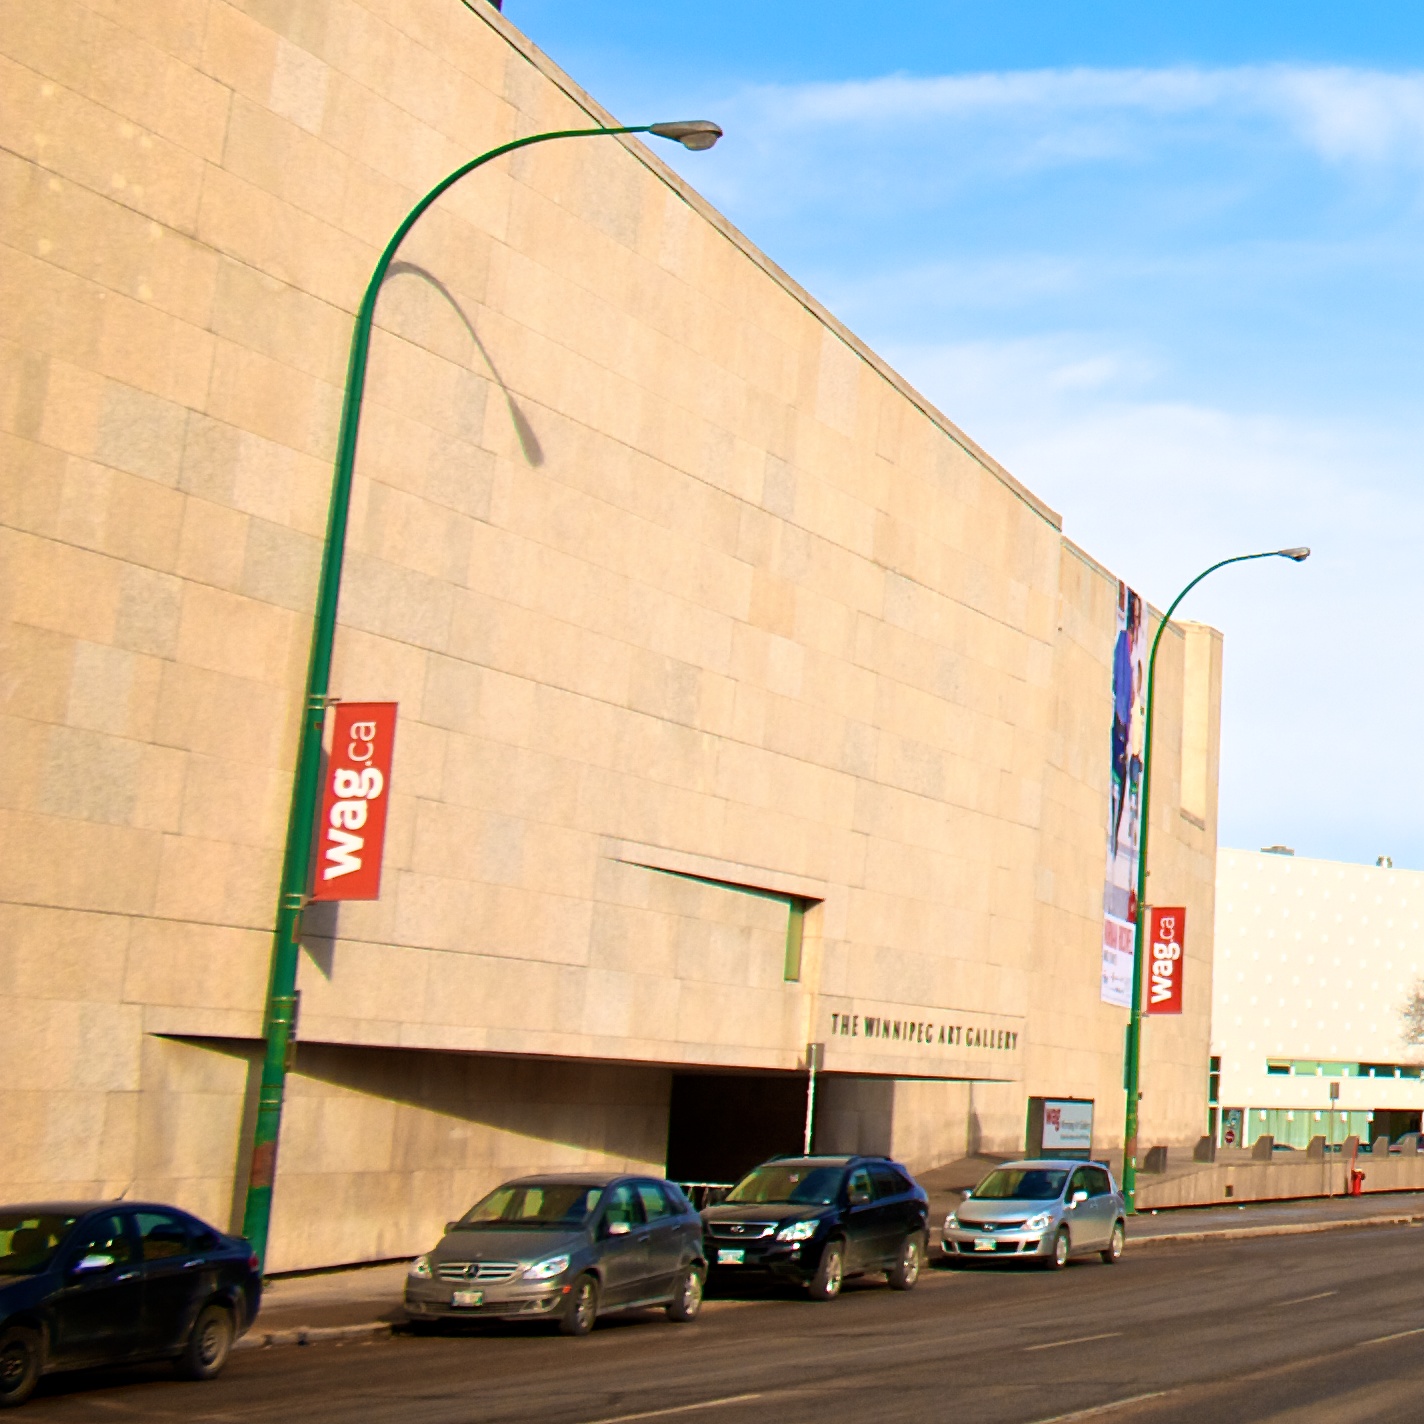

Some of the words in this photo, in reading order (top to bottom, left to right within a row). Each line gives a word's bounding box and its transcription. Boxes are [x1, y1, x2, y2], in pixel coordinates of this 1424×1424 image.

[323, 720, 384, 881] wag.ca
[1150, 917, 1181, 1004] wag.ca
[831, 1013, 859, 1037] THE
[864, 1016, 934, 1044] WINNIPEG
[938, 1025, 963, 1045] ART
[965, 1027, 1019, 1051] GALLERY
